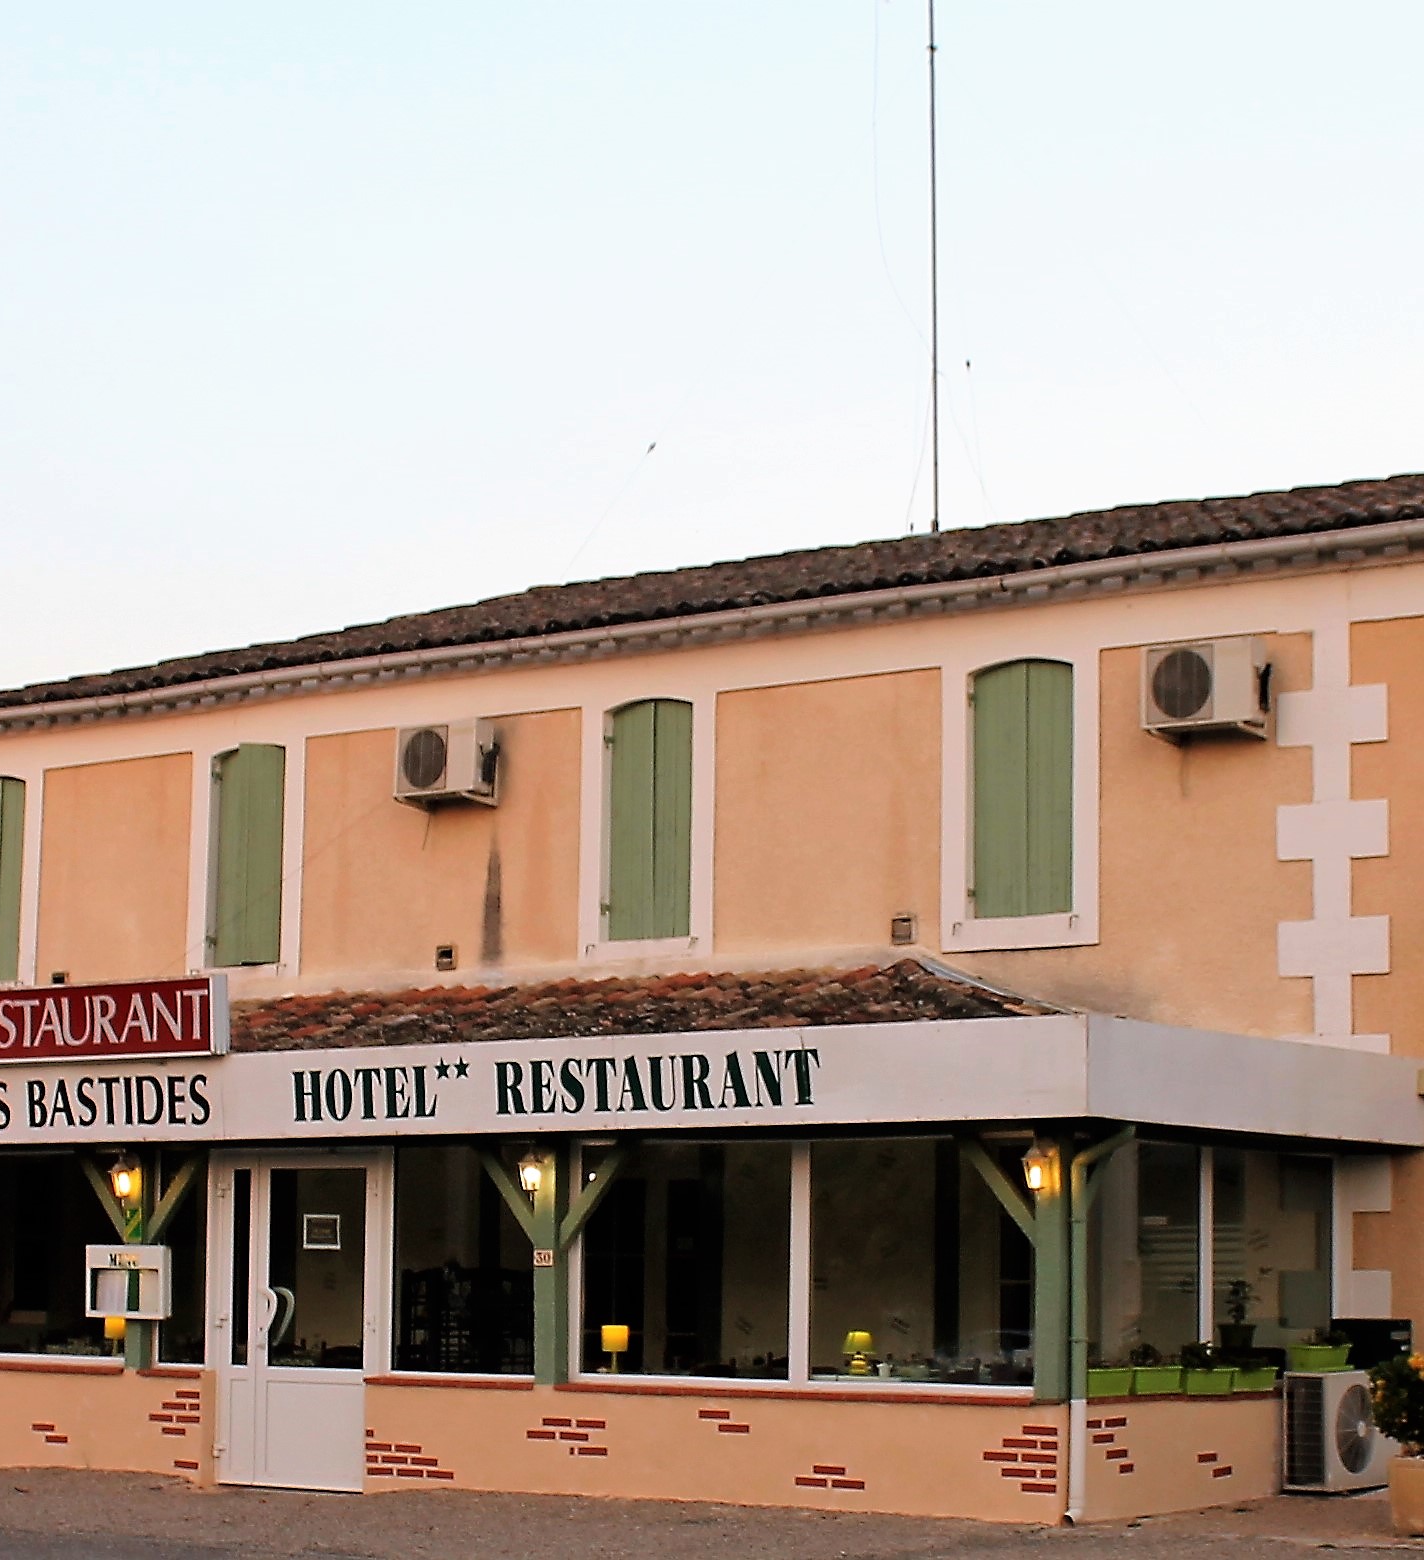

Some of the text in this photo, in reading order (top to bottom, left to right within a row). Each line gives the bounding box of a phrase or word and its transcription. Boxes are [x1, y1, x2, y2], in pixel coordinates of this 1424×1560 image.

[28, 1074, 211, 1128] BASTIDES
[292, 1048, 820, 1123] HOTEL RESTAURANT
